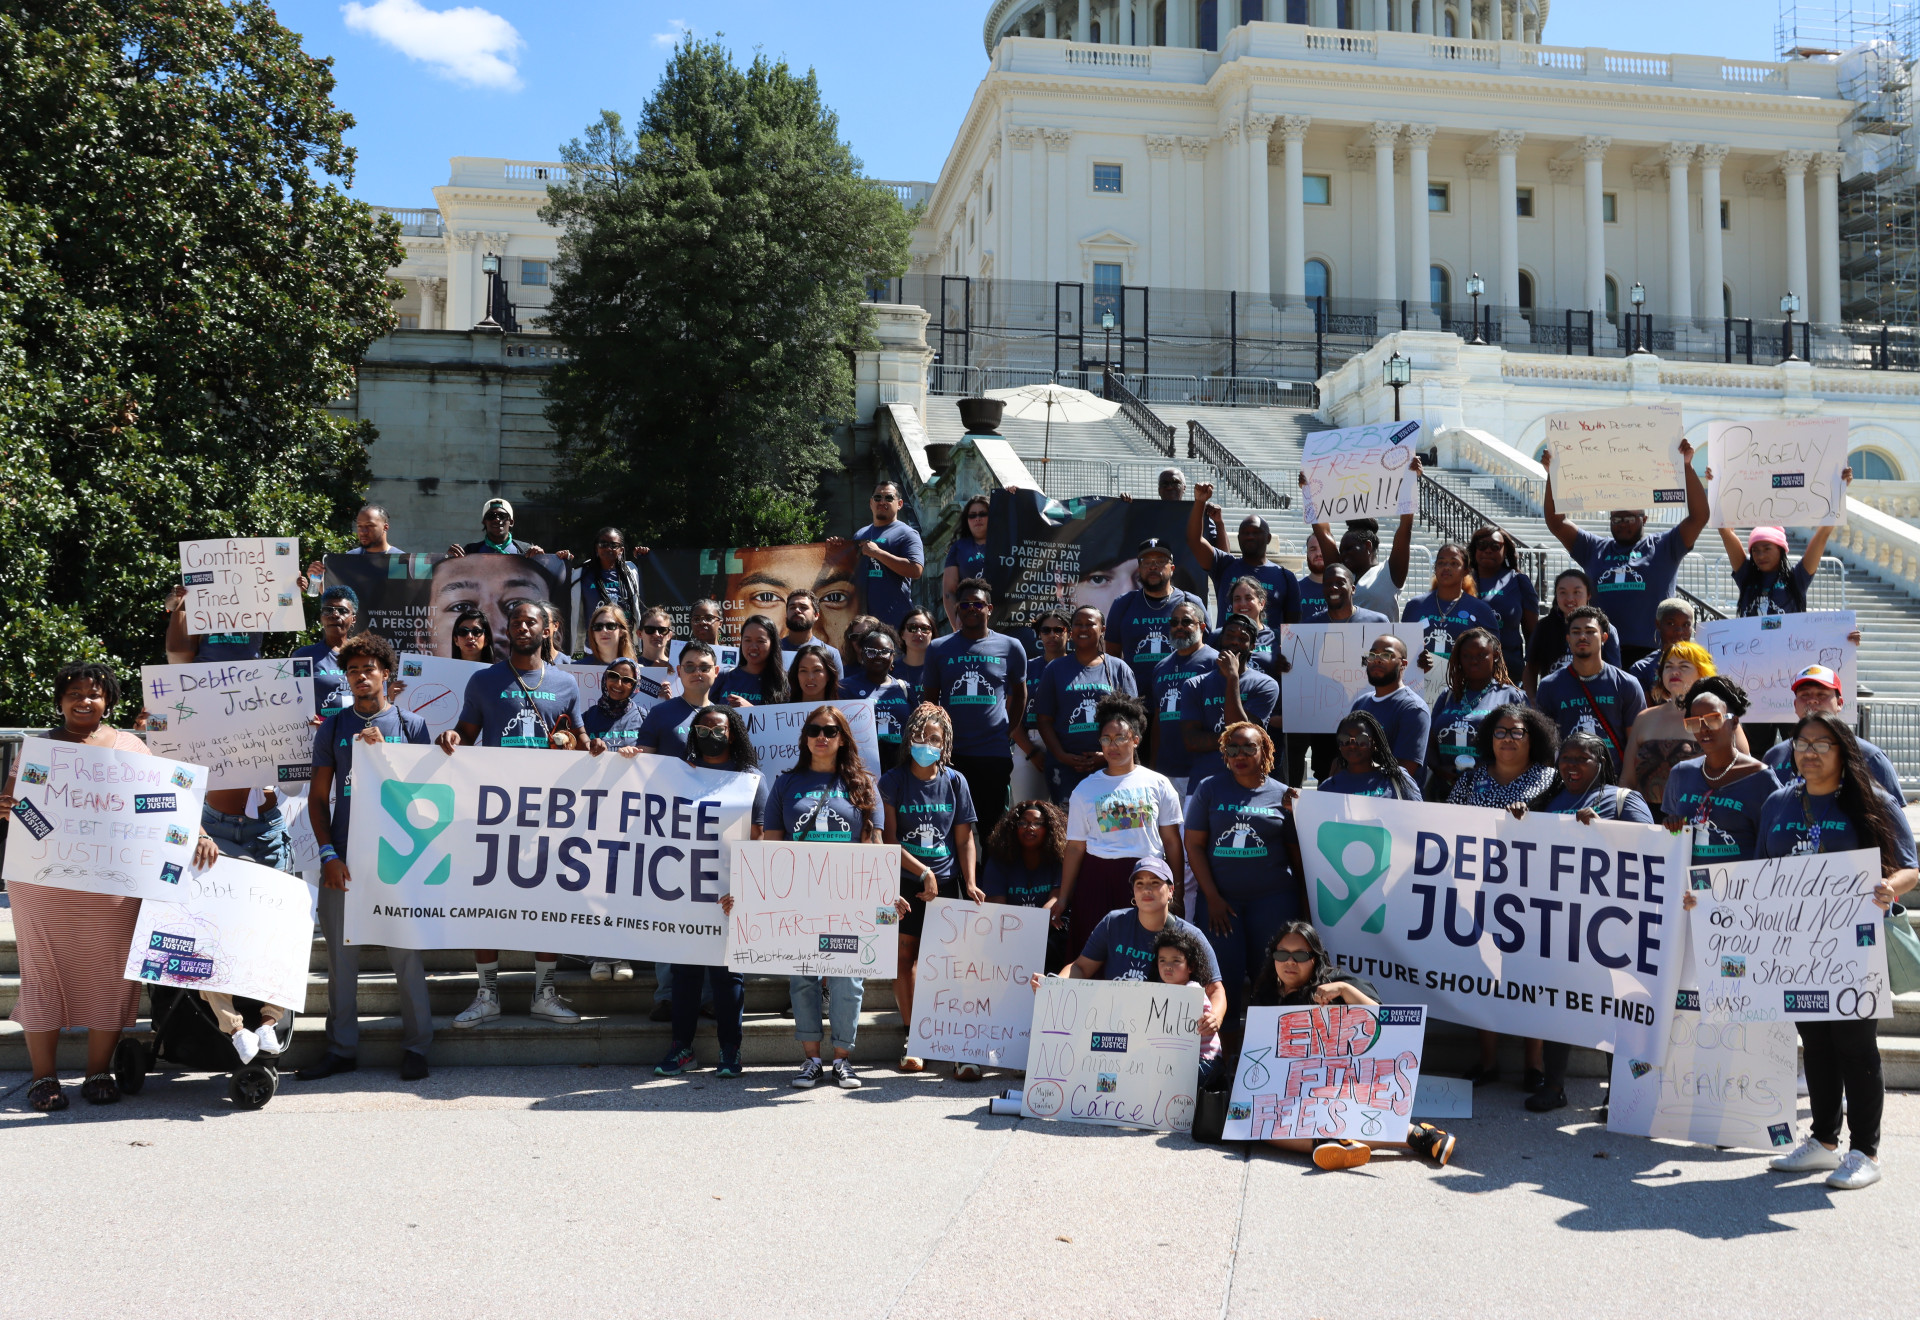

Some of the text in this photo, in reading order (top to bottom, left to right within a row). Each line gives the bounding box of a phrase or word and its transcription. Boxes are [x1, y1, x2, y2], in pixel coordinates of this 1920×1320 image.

[1578, 420, 1606, 432] Youth
[1648, 420, 1656, 428] to
[1312, 424, 1402, 455] DEBT
[1579, 438, 1600, 455] Free
[1608, 437, 1629, 453] From
[1638, 442, 1653, 452] the
[1308, 449, 1381, 480] FREE
[1560, 464, 1588, 481] Fines
[1619, 470, 1644, 481] Fees
[1337, 473, 1372, 498] IS
[186, 540, 265, 568] Confined
[999, 556, 1015, 566] TO
[1020, 558, 1043, 568] KEEP
[1012, 546, 1080, 560] PARENTS PAY
[218, 567, 275, 585] To Be
[197, 586, 239, 606] Fined
[1016, 583, 1077, 597] LOCKED UP,
[405, 606, 438, 616] LIMIT
[1011, 612, 1025, 621] TO
[1019, 601, 1026, 610] A
[368, 618, 437, 630] A PERSON,
[1707, 630, 1764, 657] Free
[958, 655, 1000, 664] FUTURE
[1163, 672, 1197, 681] FUTURE
[1730, 660, 1797, 694] Youth
[511, 691, 556, 701] FUTURE
[189, 738, 206, 752] you
[211, 736, 229, 745] are
[233, 729, 252, 742] not
[244, 739, 266, 752] why
[271, 736, 291, 746] are
[51, 747, 160, 786] FREEDOM
[44, 783, 124, 812] MEANS
[147, 801, 176, 809] JUSTICE
[909, 804, 952, 813] FUTURE
[1228, 804, 1275, 816] FUTURE
[477, 785, 722, 841] DEBT FREE
[110, 822, 161, 840] FREE
[31, 838, 156, 866] JUSTICE
[472, 833, 720, 903] JUSTICE
[1414, 831, 1665, 904] DEBT FREE
[1712, 857, 1874, 902] Our Children
[373, 905, 722, 936] A NATIONAL CAMPAIGN TO END FEES & FINES FOR YOUTH
[756, 910, 875, 937] TARIFAS
[940, 906, 1023, 944] STOP
[1740, 894, 1867, 932] Should NOT
[1407, 883, 1663, 976] JUSTICE
[161, 942, 193, 952] JUSTICE
[1705, 930, 1838, 967] grow in to
[923, 954, 1029, 985] STEALING
[1336, 954, 1655, 1026] FUTURE SHOULDN'T BE FINED
[933, 989, 992, 1017] FROM
[1041, 989, 1200, 1036] NO a las Multas
[1704, 995, 1751, 1013] GRASP
[1713, 1008, 1778, 1022] COLORADO
[1797, 1001, 1828, 1009] JUSTICE
[918, 1016, 1014, 1041] CHILDREN
[930, 1041, 955, 1059] they
[1034, 1042, 1174, 1077] NO niños en la
[1285, 1051, 1418, 1116] FINES
[1070, 1085, 1163, 1125] Cárcel
